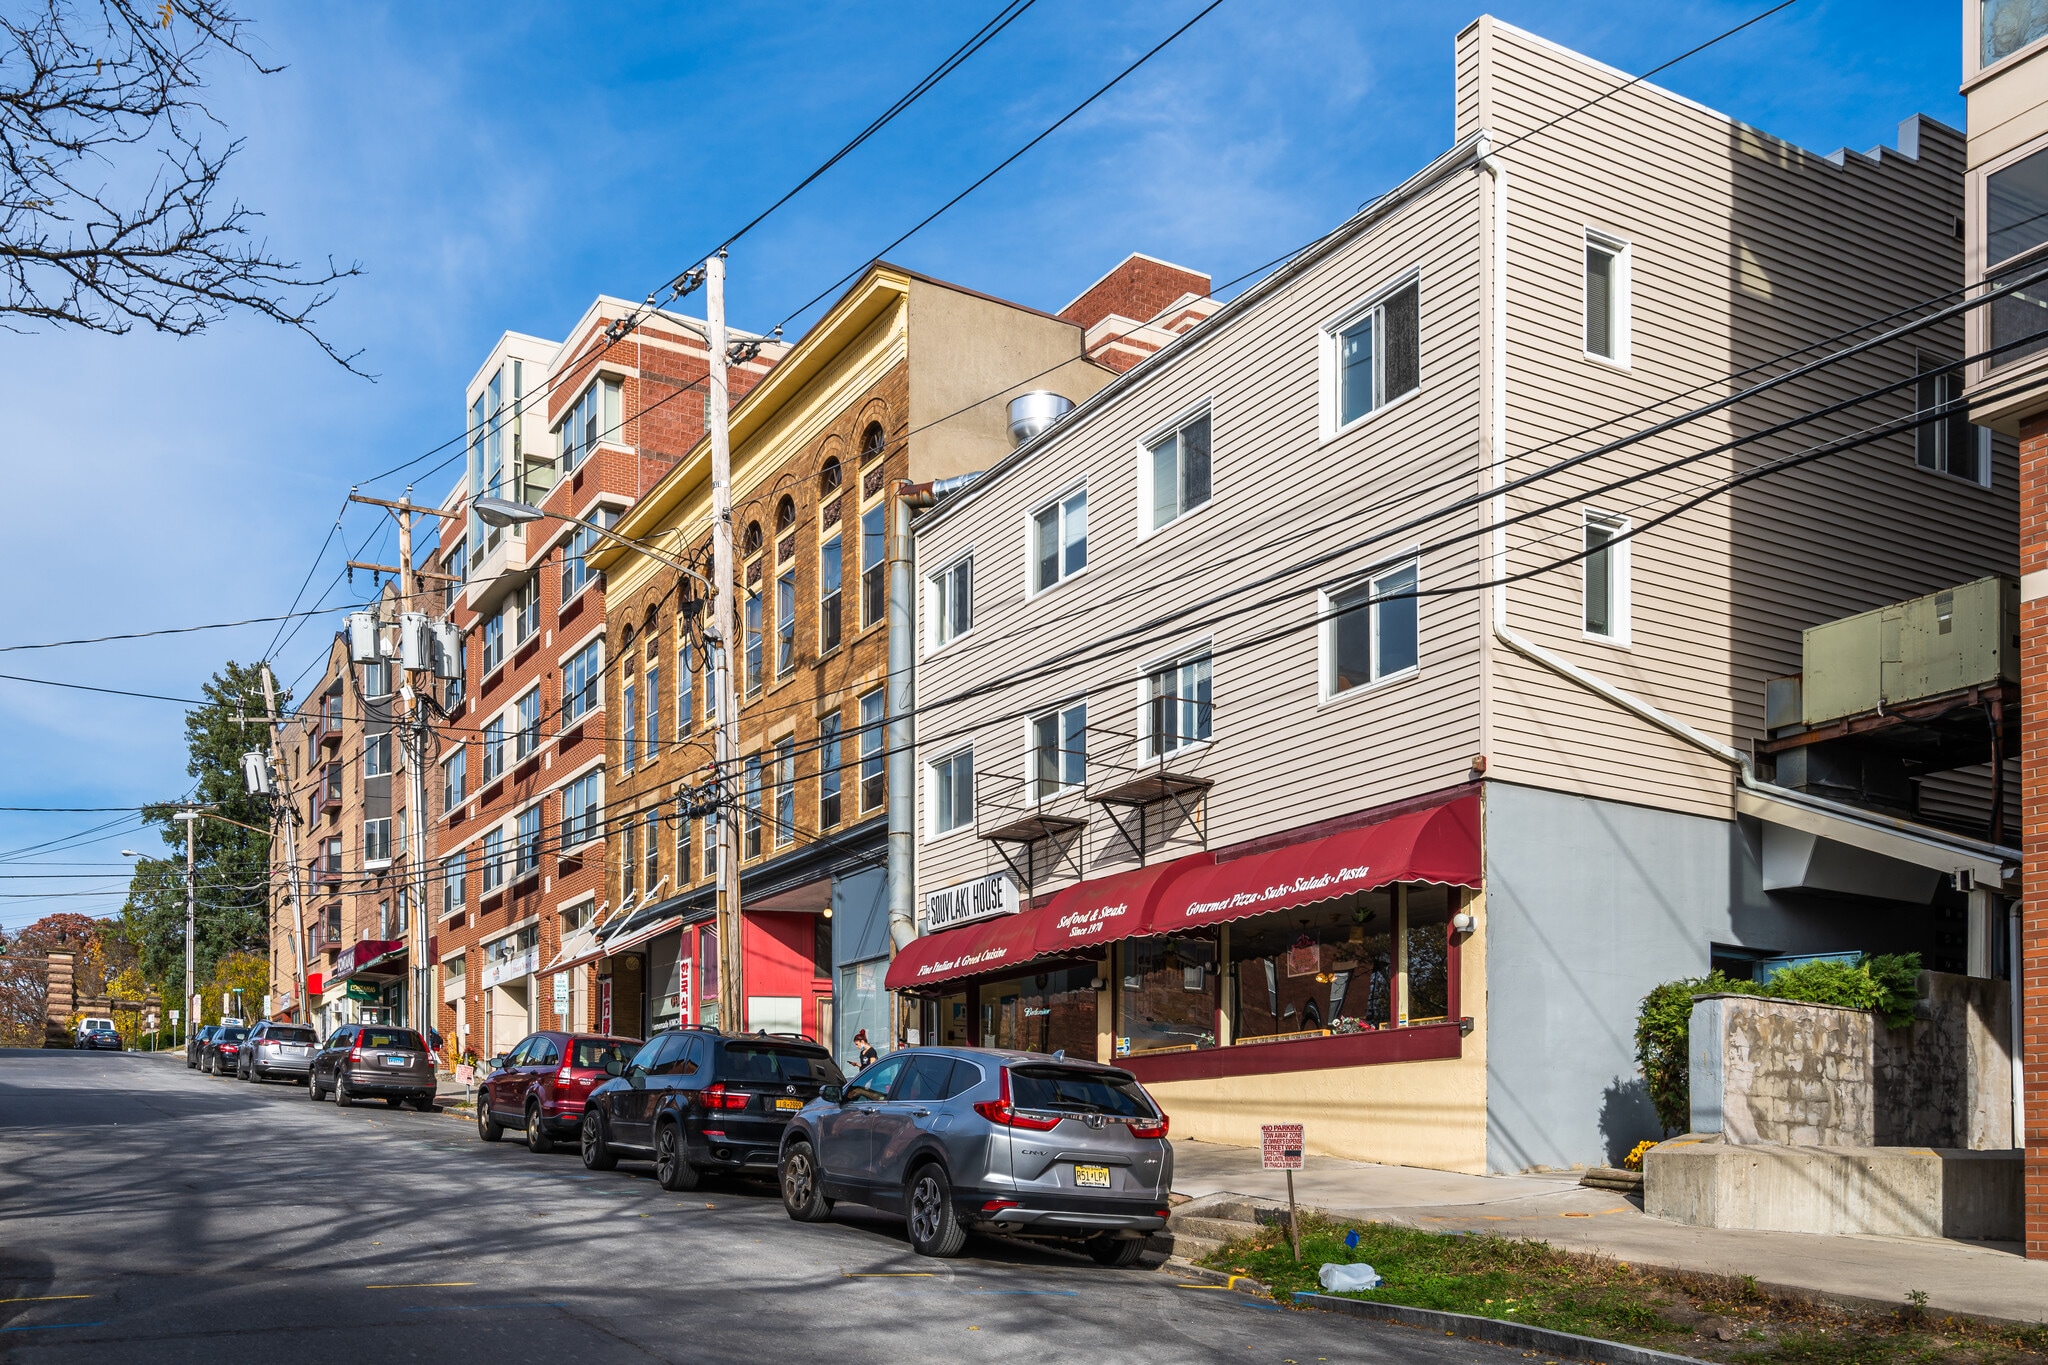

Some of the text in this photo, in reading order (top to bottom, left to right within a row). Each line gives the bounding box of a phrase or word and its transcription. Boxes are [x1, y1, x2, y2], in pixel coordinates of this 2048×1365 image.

[930, 877, 1004, 926] SOUVLAKI HOUSE
[1185, 865, 1370, 917] Gourmet Pizza Subs Salads Pasta
[1056, 902, 1128, 929] Seafood & Steaks
[1068, 921, 1104, 937] Since 1970
[917, 947, 1008, 977] Fine Italian & Greek Cuisine
